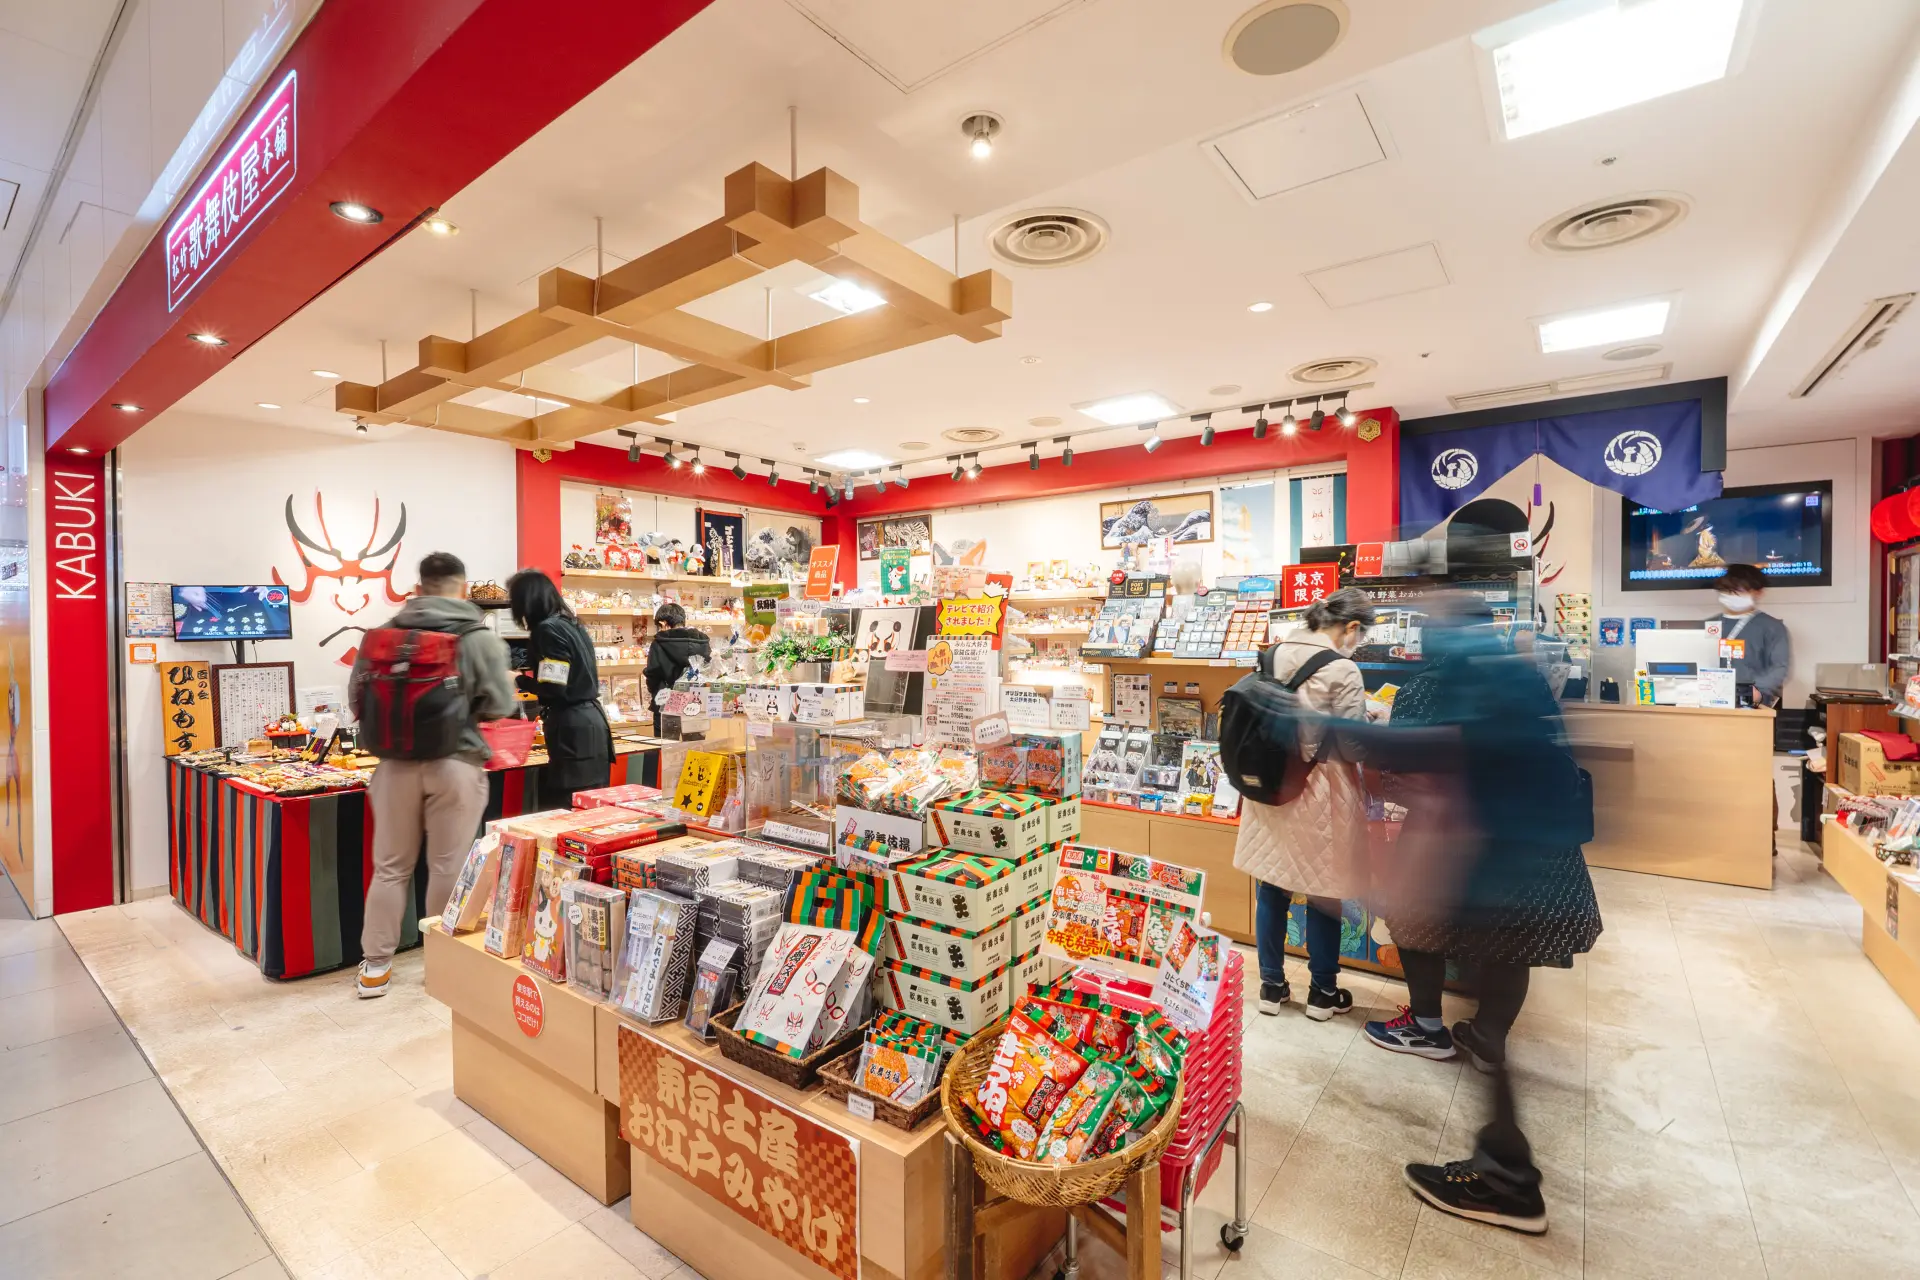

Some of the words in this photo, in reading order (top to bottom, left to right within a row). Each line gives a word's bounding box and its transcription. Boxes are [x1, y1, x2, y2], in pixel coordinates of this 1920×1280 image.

[54, 471, 97, 600] KABUKI
[811, 560, 833, 568] オススメ
[1293, 571, 1325, 588] 東京
[1294, 587, 1325, 603] 限定
[946, 604, 995, 614] テレビで紹介
[1129, 860, 1149, 879] 45
[1159, 871, 1180, 885] 65
[656, 1053, 799, 1180] 東京土産
[628, 1093, 845, 1263] お江戸みやげ
